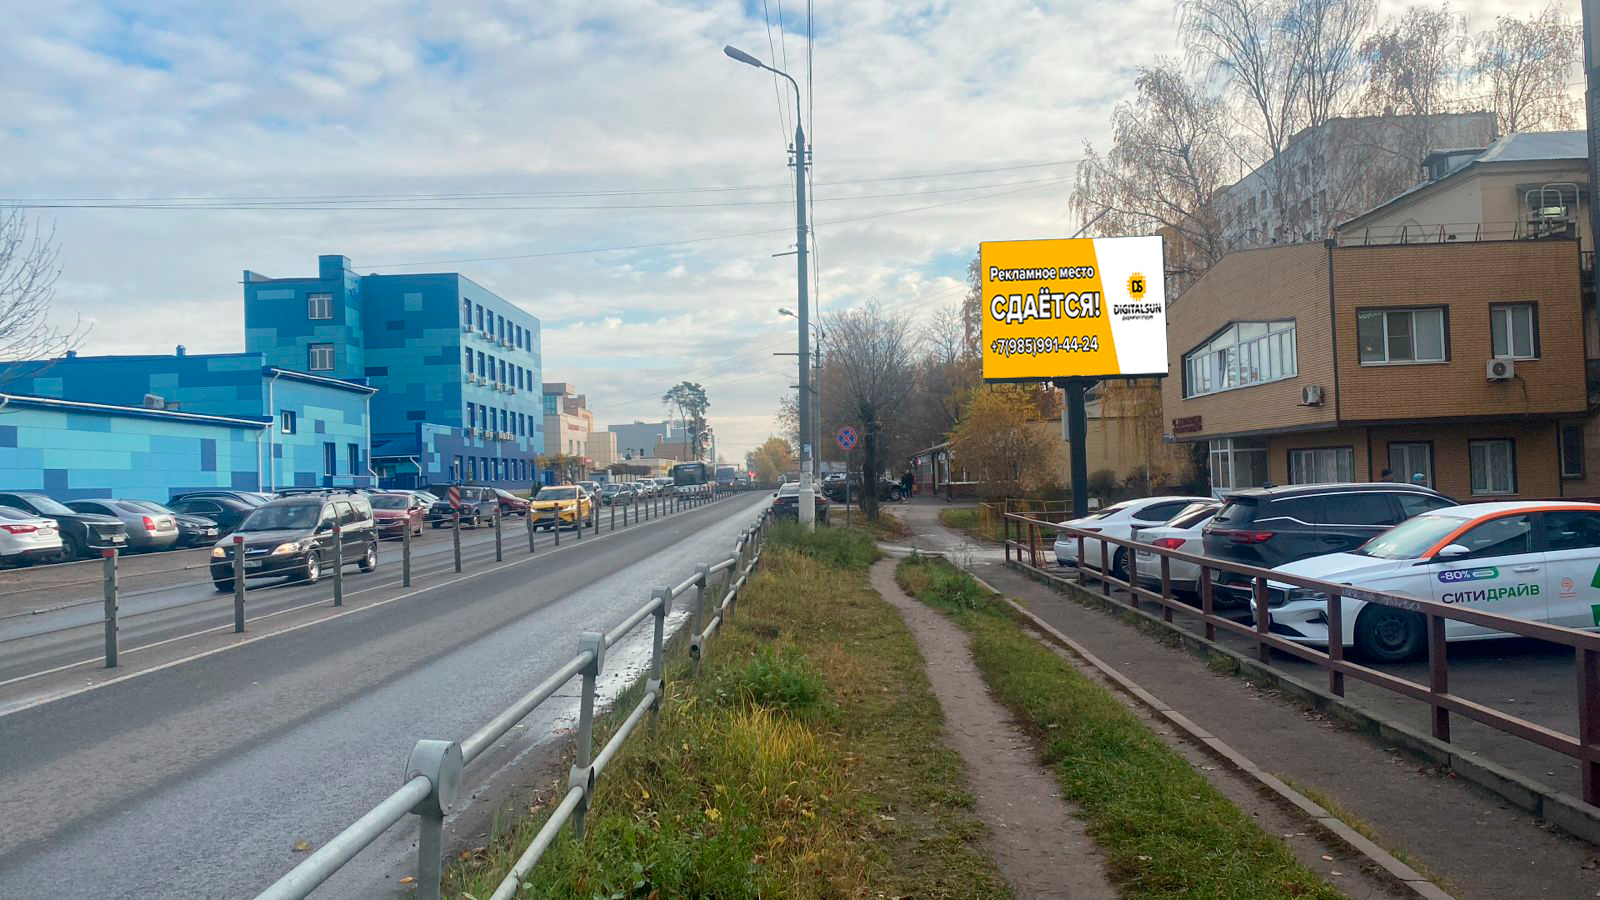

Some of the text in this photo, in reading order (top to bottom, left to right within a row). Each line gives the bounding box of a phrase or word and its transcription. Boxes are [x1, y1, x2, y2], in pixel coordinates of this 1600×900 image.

[990, 266, 1094, 281] Рекламное место
[990, 287, 1101, 324] СДАЁТСЯ!
[990, 335, 1099, 358] +7(985)991-44-24
[1440, 570, 1471, 580] -80%
[1441, 583, 1540, 604] СИТИДРАЙВ
